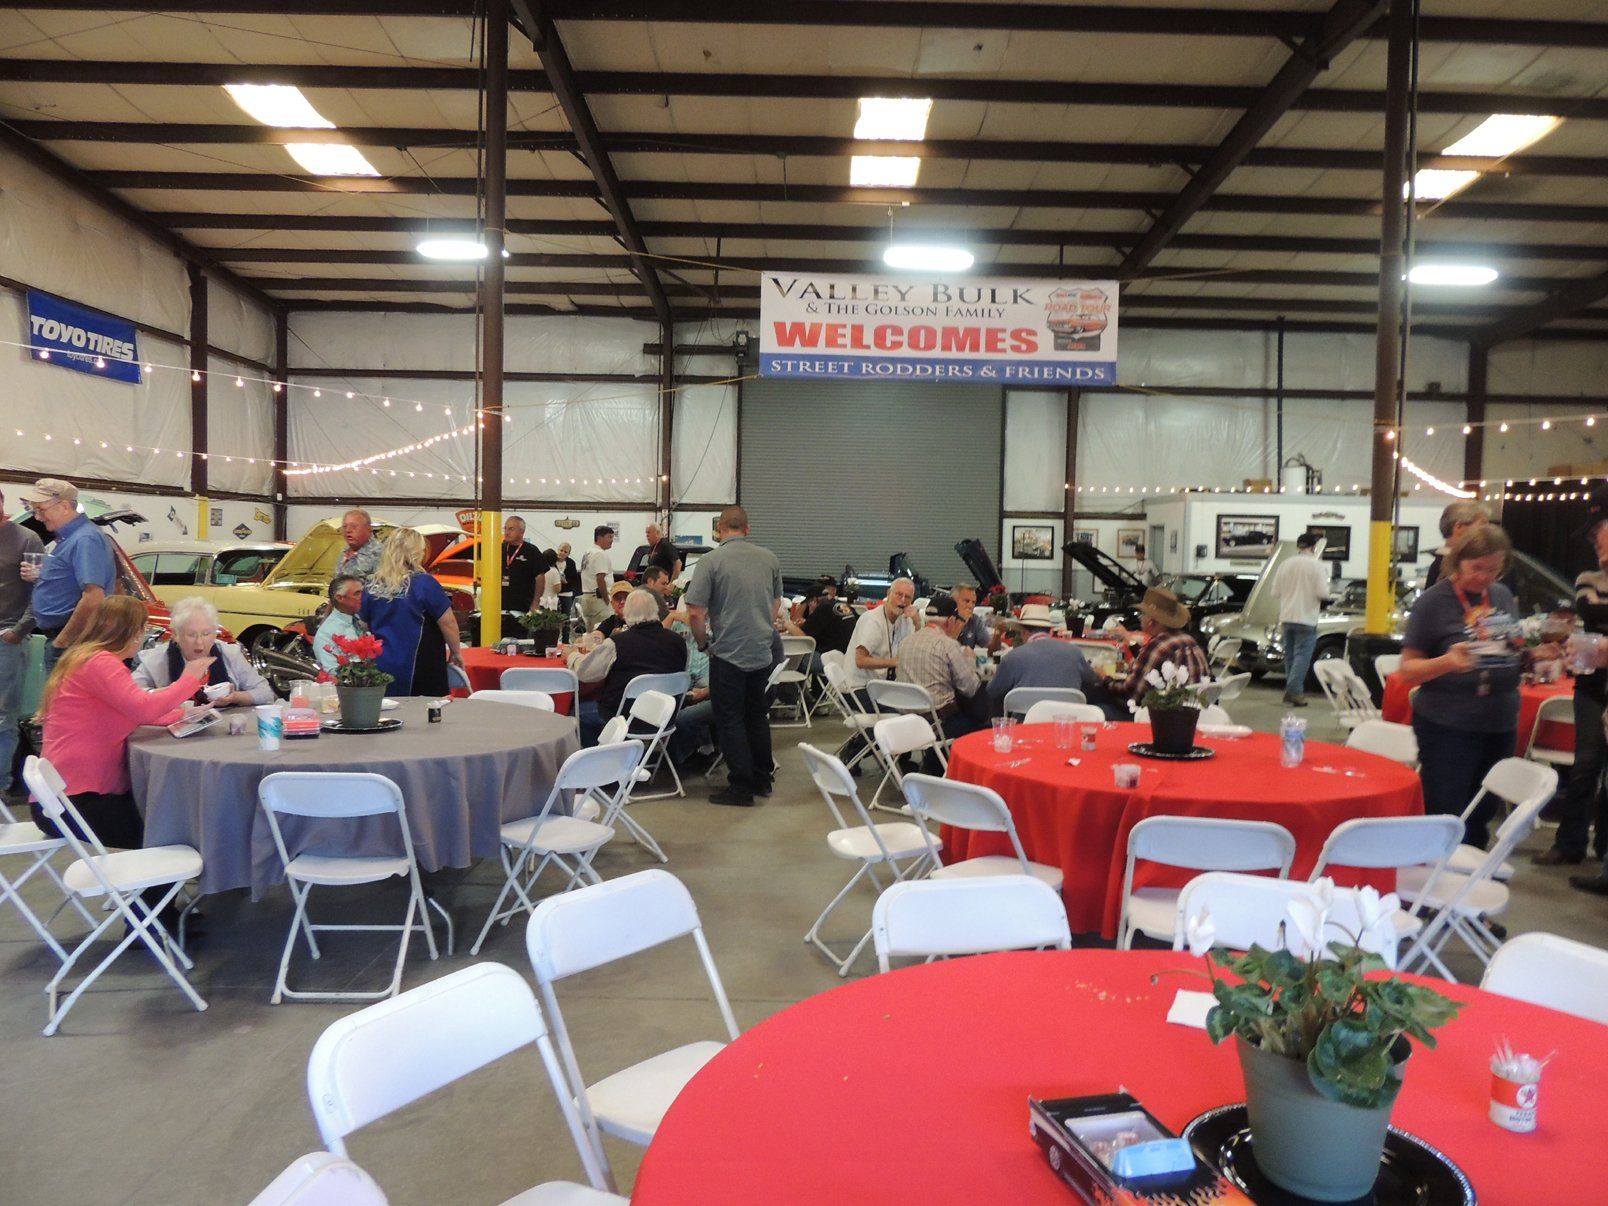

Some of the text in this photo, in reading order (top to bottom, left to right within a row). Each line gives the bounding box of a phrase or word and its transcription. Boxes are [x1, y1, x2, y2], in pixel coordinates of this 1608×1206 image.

[771, 278, 1036, 305] VALLEY BULK
[806, 302, 1005, 319] & THE GOLSON FAMILY
[1044, 303, 1111, 313] ROAD TOUR
[31, 315, 134, 360] TOYO TIRES
[773, 321, 1039, 354] WELCOMES
[771, 359, 1105, 380] STREET RODDERS & FRIENDS
